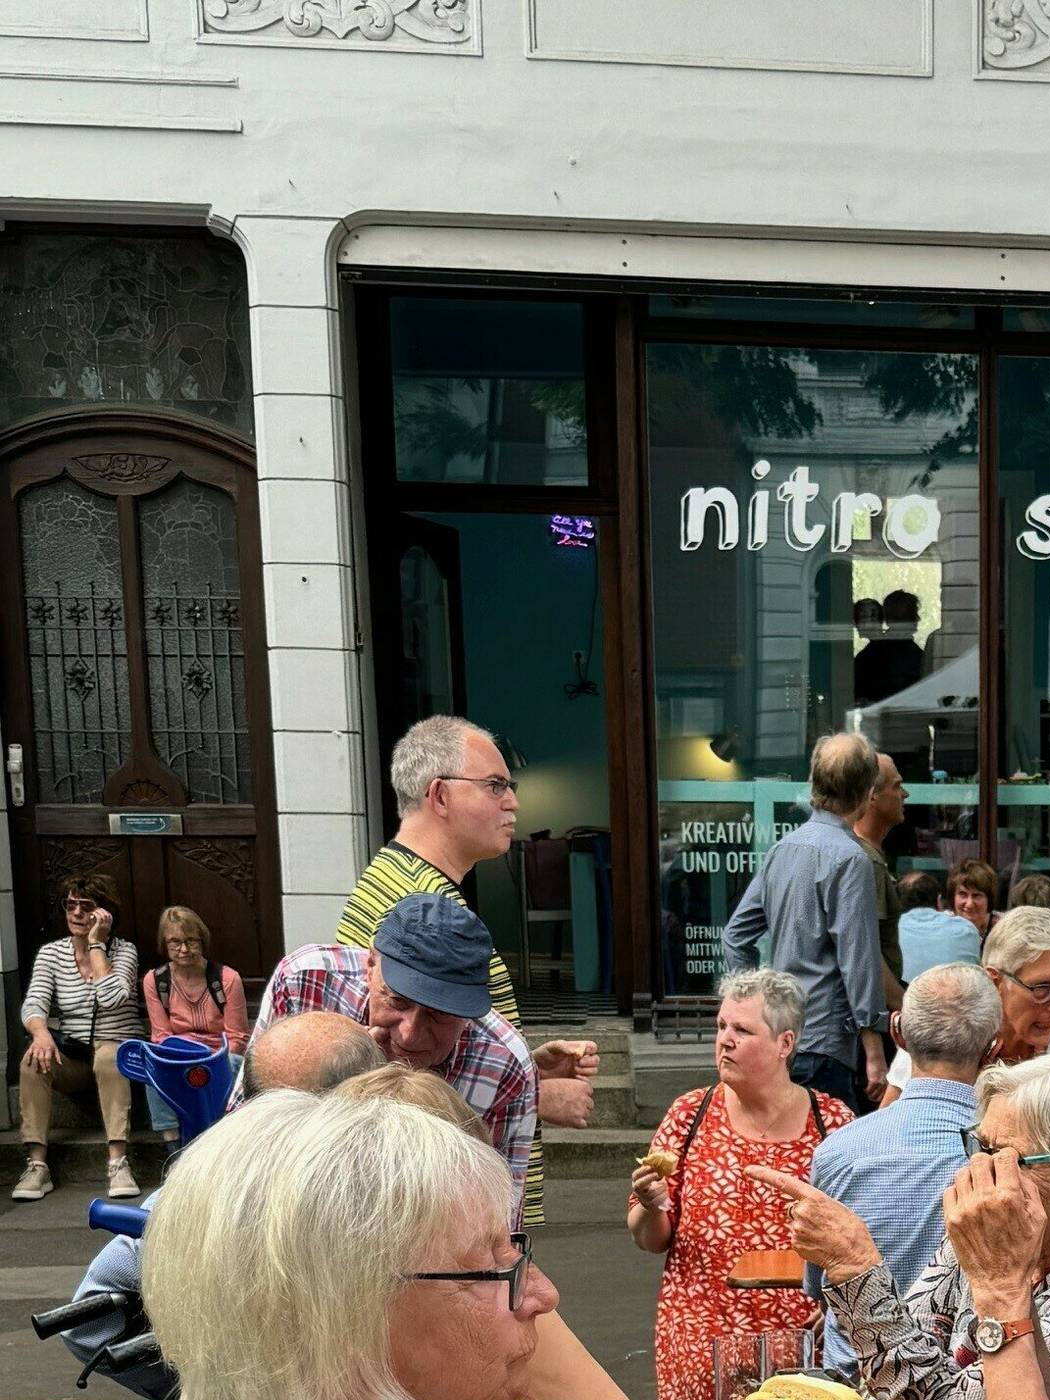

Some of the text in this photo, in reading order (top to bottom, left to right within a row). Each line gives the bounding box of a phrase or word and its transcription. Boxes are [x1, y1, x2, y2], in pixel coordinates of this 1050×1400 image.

[680, 460, 942, 559] nitro
[681, 821, 801, 843] KREATIVWER
[682, 851, 720, 873] UND
[687, 961, 716, 974] ODER
